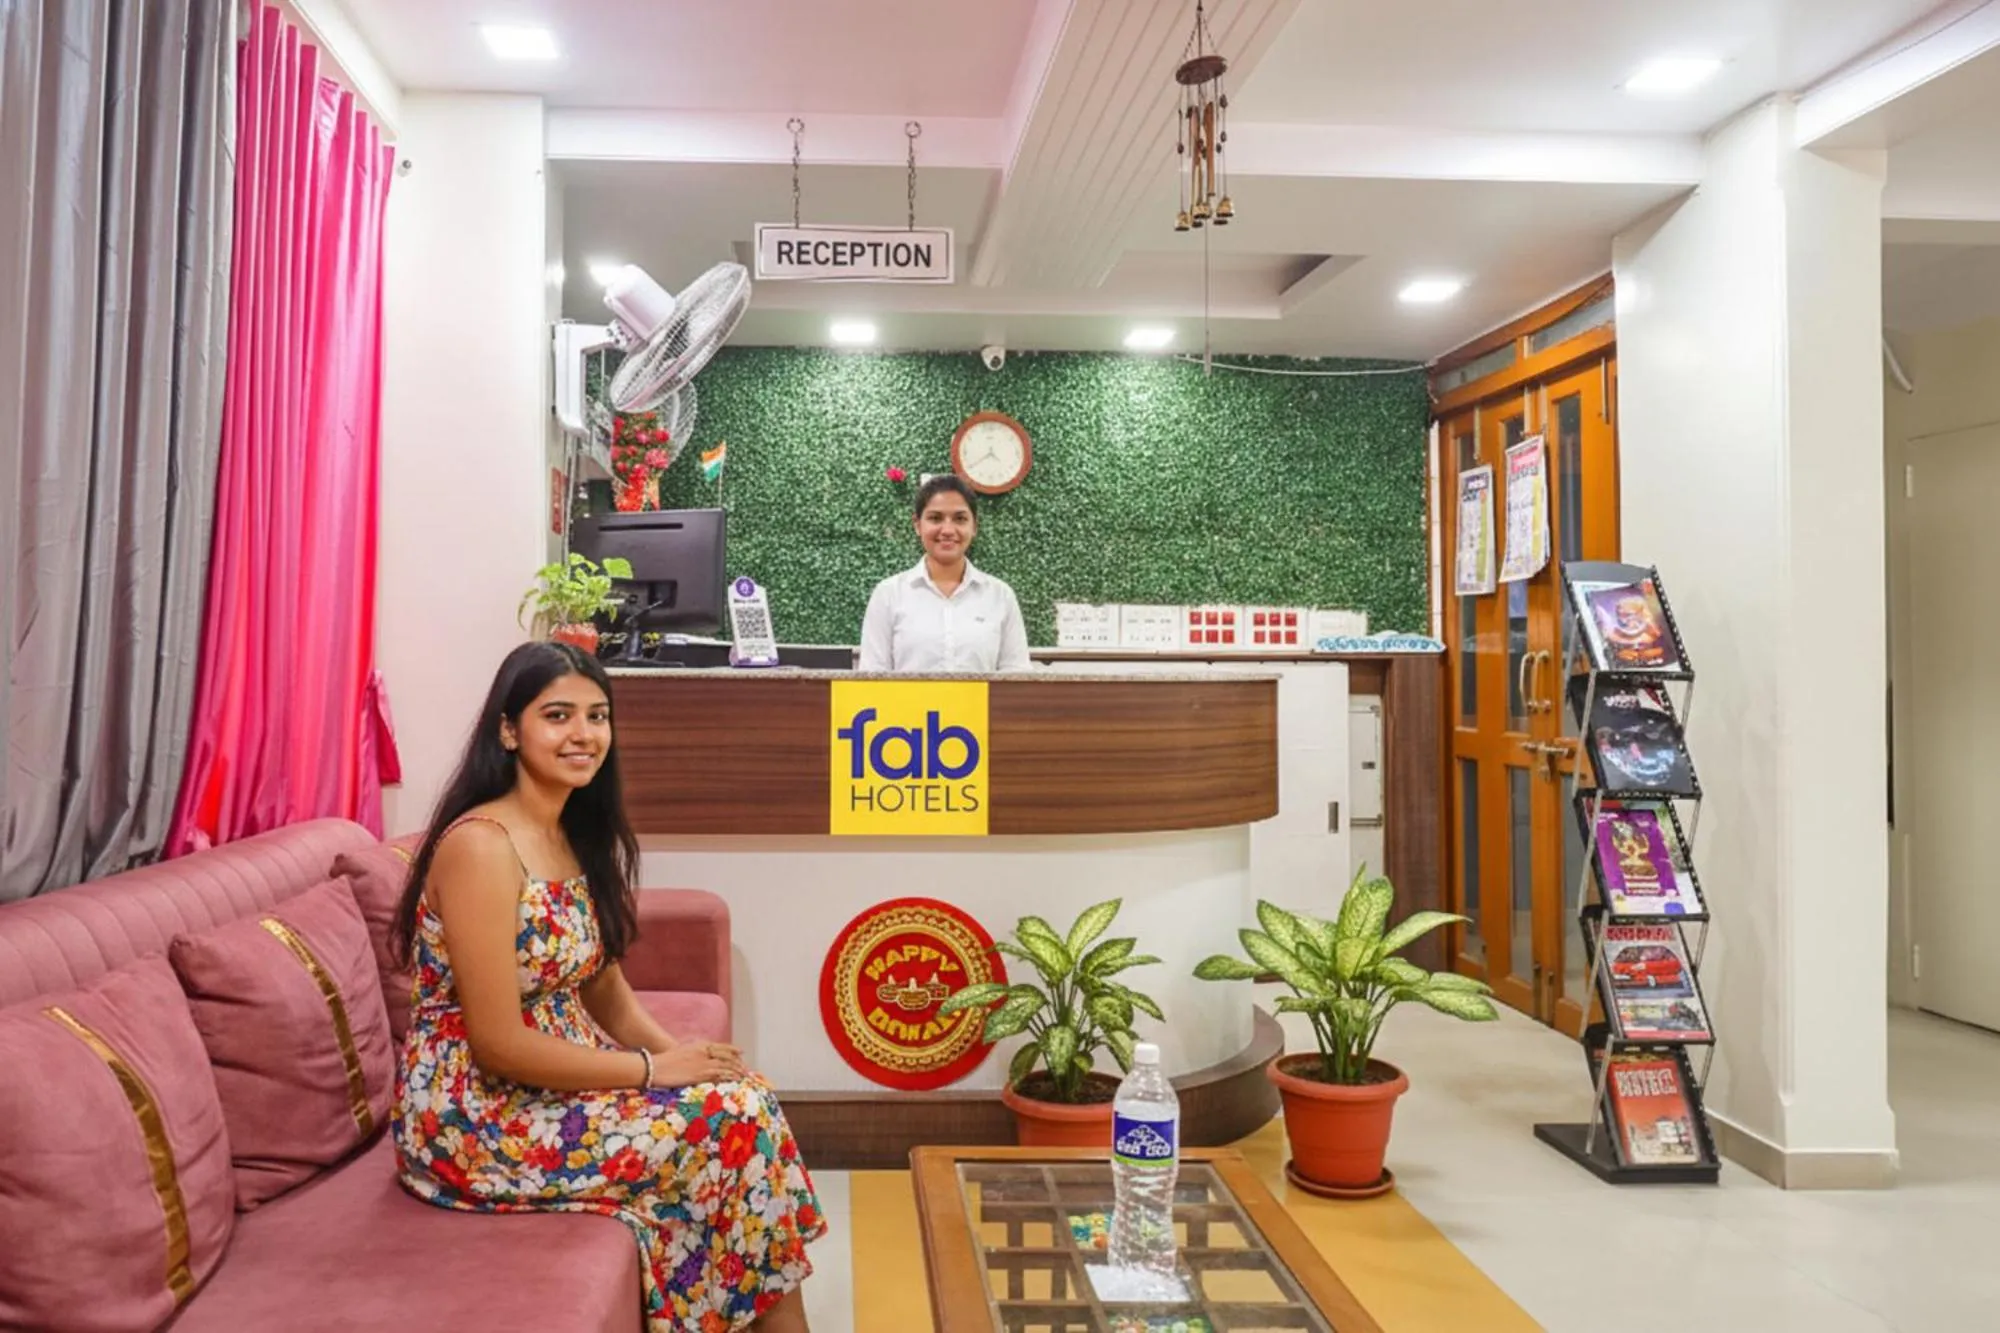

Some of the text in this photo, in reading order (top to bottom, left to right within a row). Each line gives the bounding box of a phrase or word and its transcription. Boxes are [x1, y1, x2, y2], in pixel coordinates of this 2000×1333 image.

[776, 240, 932, 268] RECEPTION
[837, 707, 980, 780] fab
[851, 784, 980, 812] HOTELS
[864, 944, 960, 981] HAPPY
